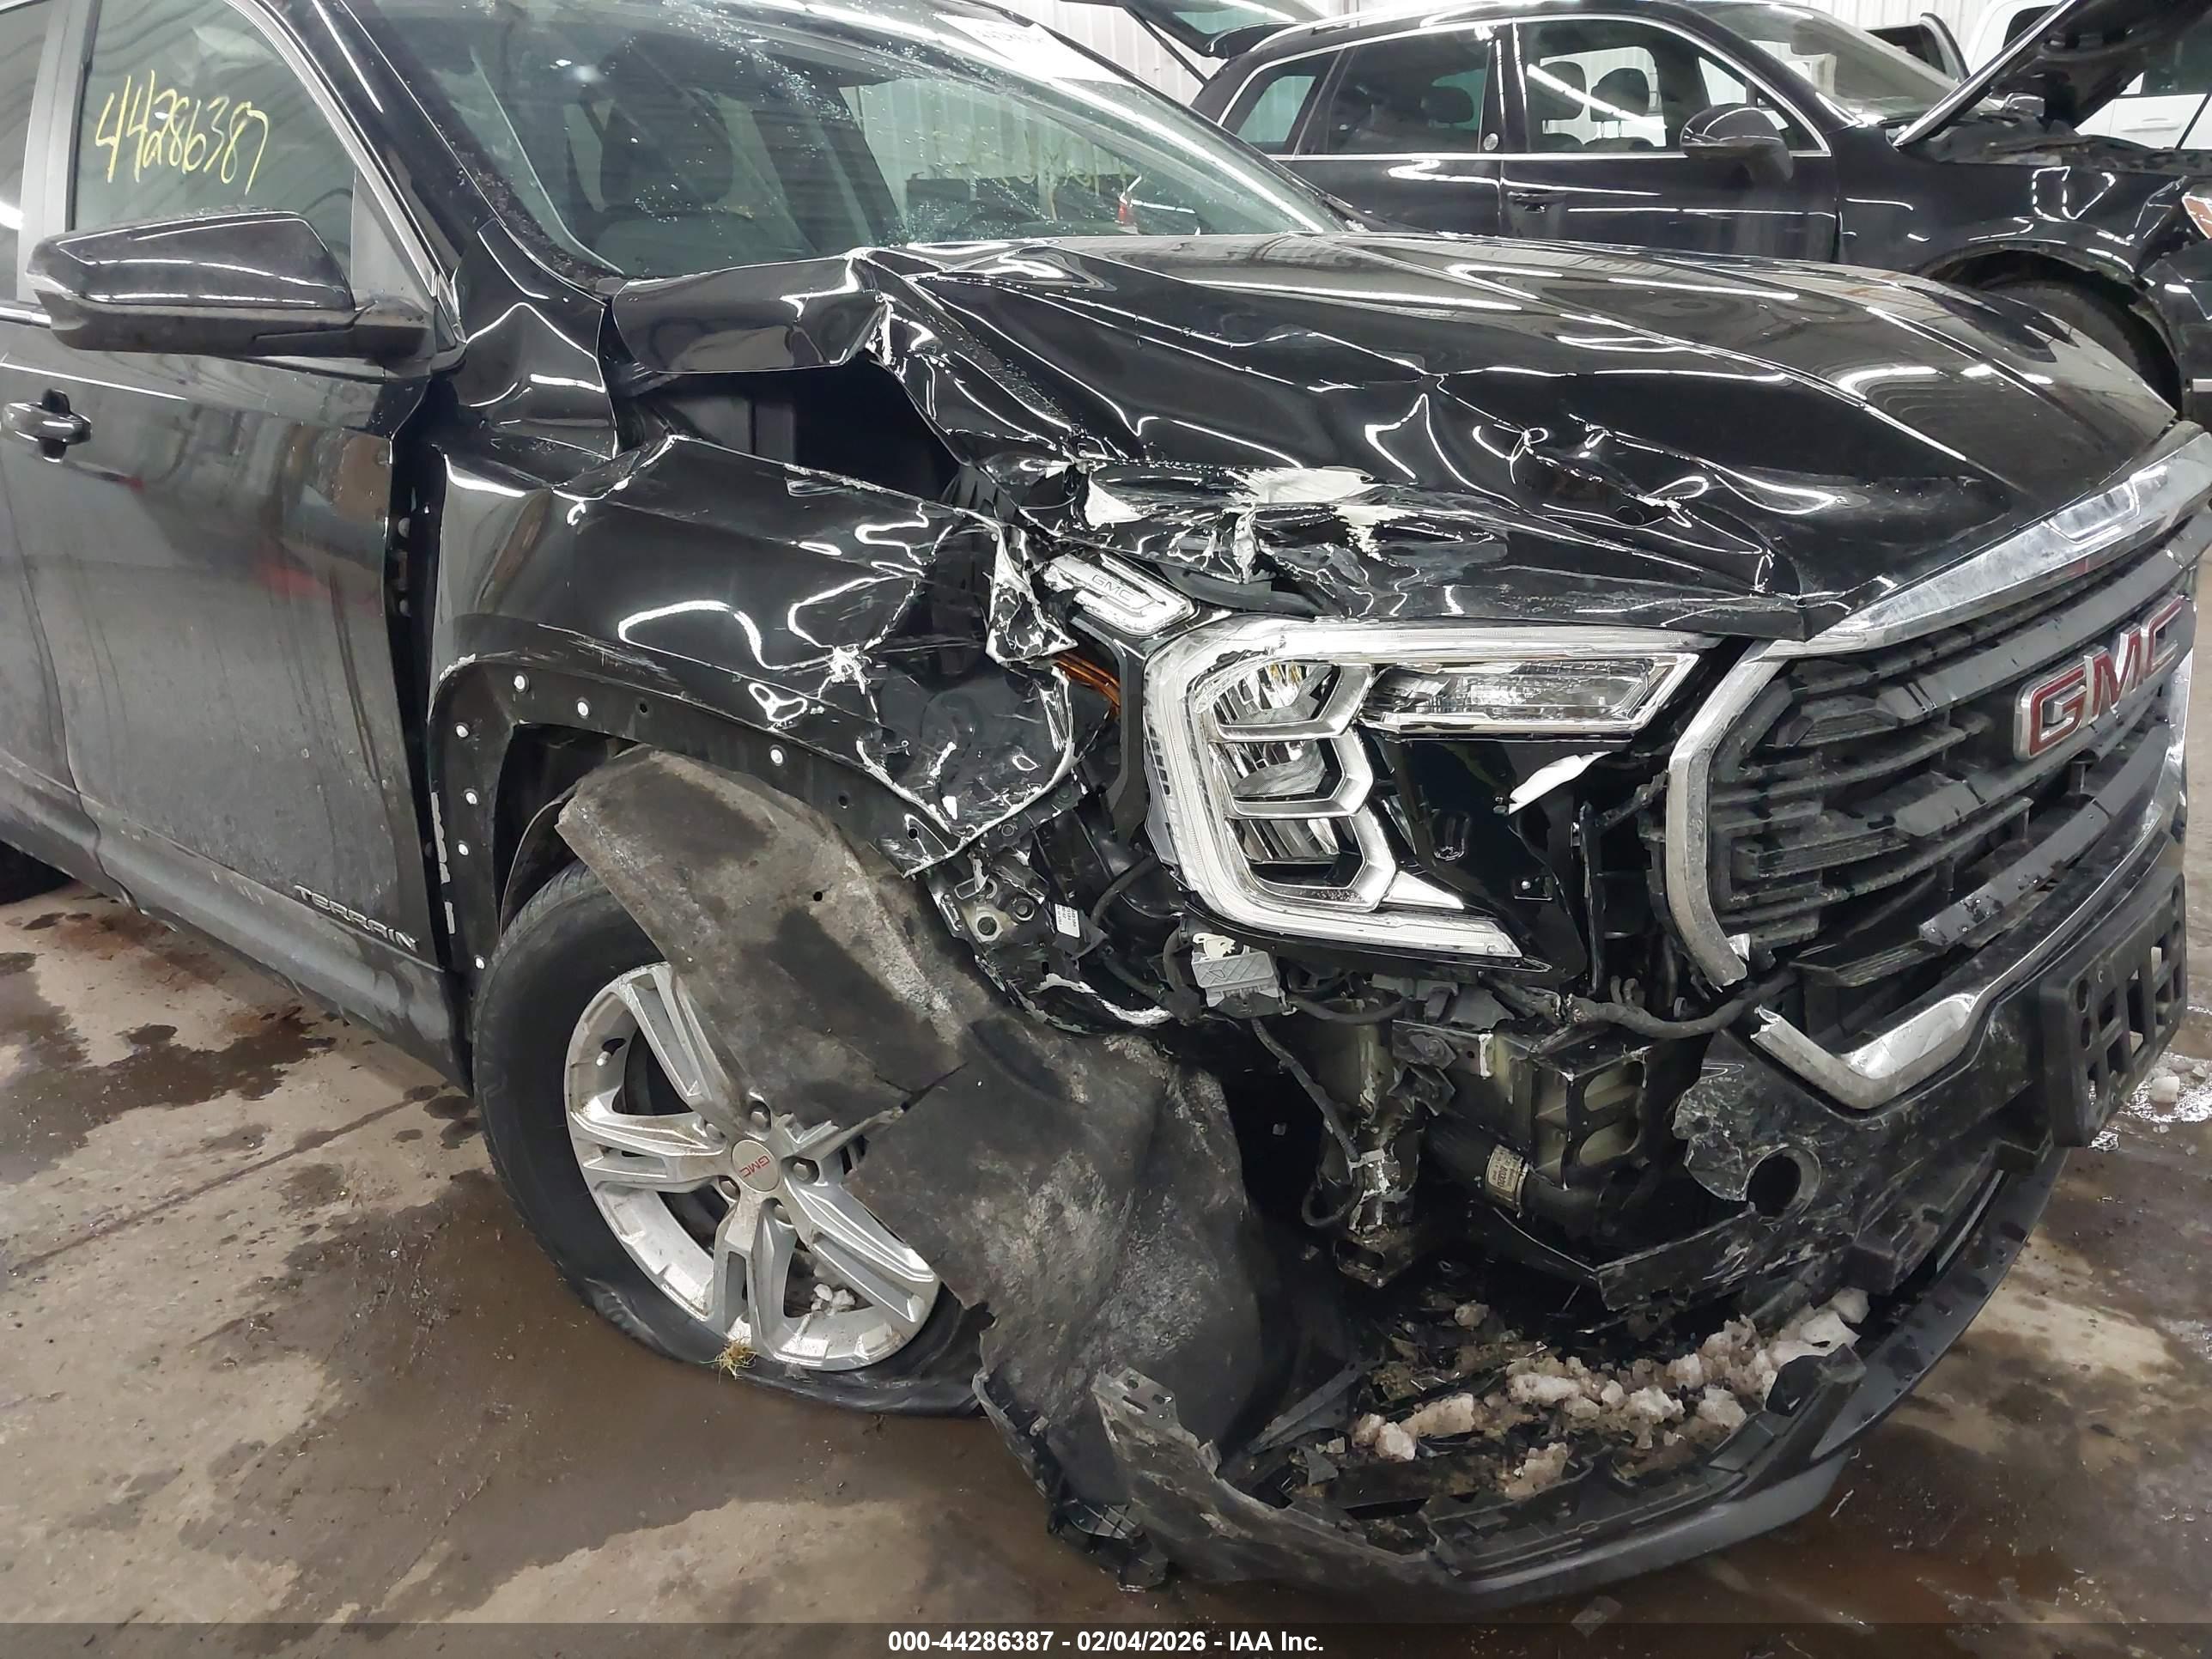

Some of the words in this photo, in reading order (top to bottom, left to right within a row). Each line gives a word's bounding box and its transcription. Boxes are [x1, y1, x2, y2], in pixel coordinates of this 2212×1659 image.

[95, 70, 269, 195] 44286387
[1092, 574, 1134, 602] GMC
[2014, 595, 2189, 760] GMC
[294, 883, 419, 953] TERRAIN
[739, 1155, 770, 1178] GMC
